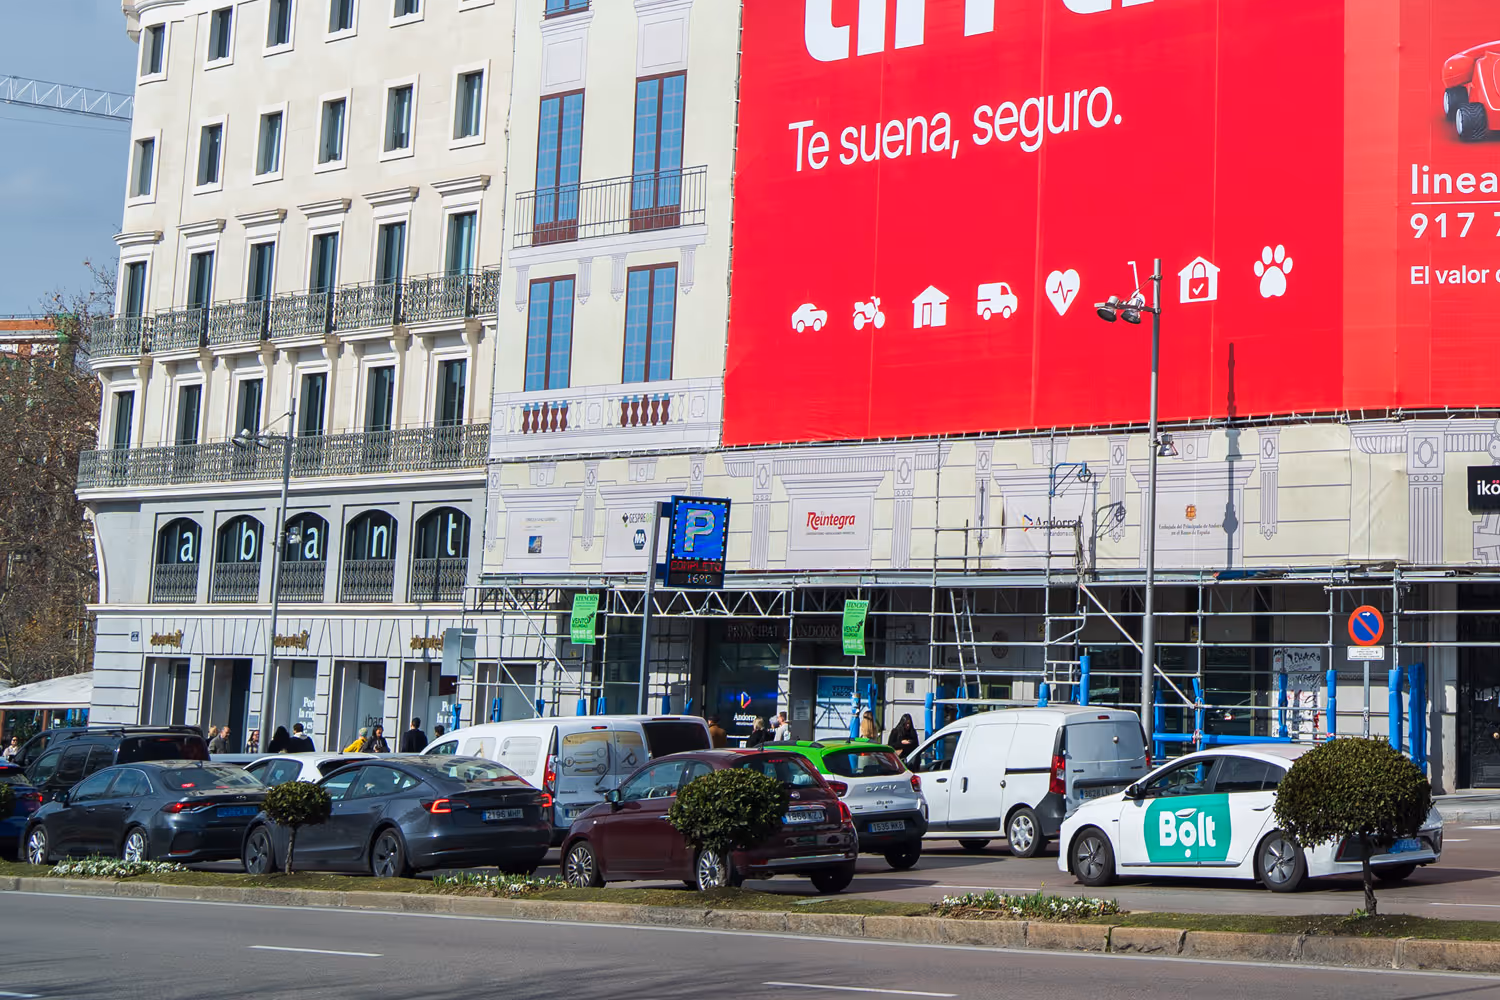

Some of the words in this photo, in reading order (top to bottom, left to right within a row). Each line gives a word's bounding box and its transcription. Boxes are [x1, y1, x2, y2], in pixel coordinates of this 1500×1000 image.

[788, 119, 830, 172] Te
[839, 111, 960, 166] suena,
[972, 85, 1123, 153] seguro.
[1411, 162, 1498, 195] linea
[1409, 211, 1476, 239] 917
[1410, 265, 1430, 285] El
[1435, 264, 1490, 285] valor
[683, 508, 716, 553] P
[806, 511, 856, 531] Reintegra
[670, 560, 722, 573] COMPLETO
[1159, 808, 1217, 849] Bolt
